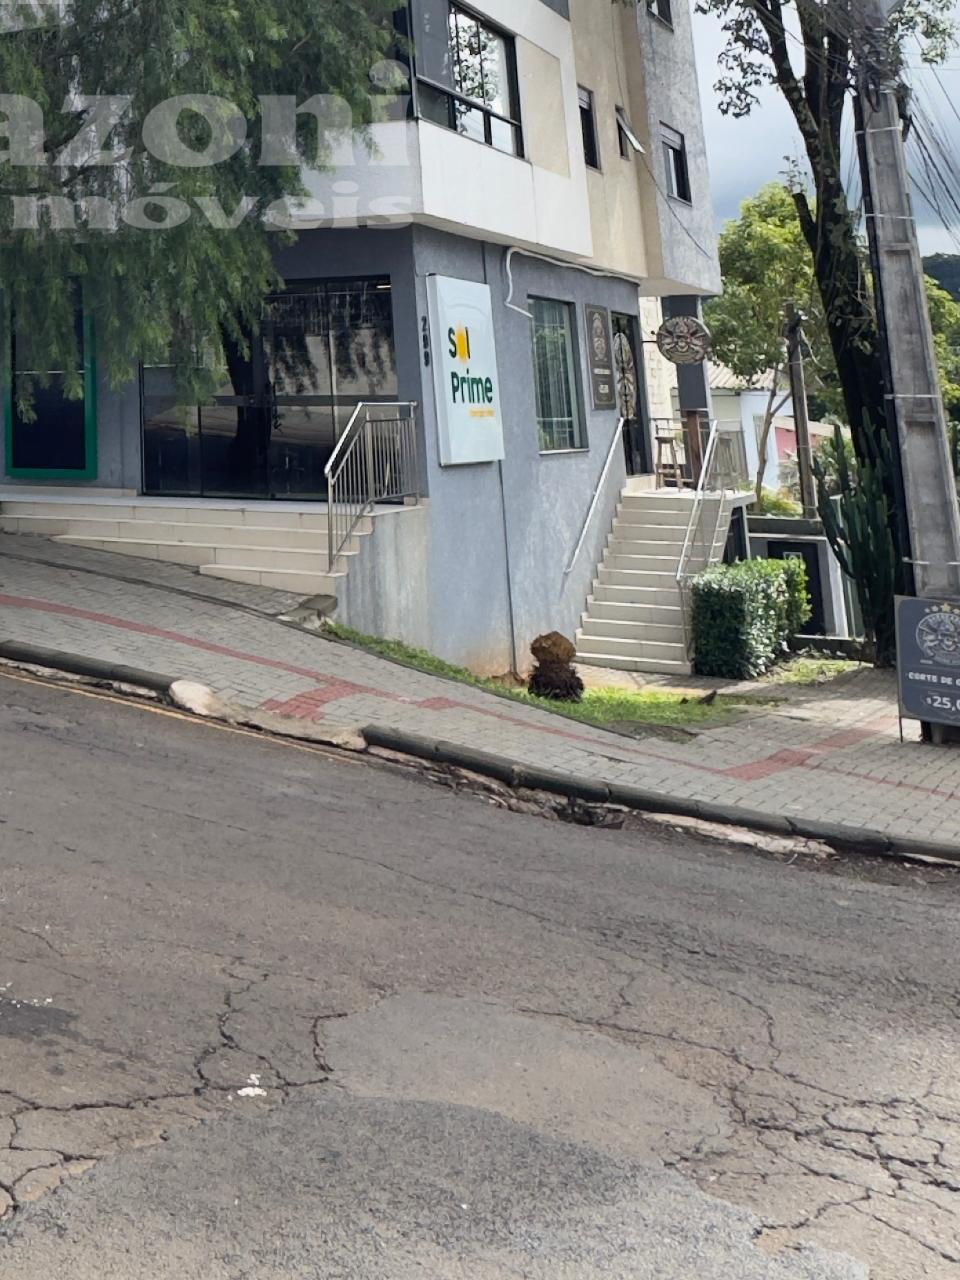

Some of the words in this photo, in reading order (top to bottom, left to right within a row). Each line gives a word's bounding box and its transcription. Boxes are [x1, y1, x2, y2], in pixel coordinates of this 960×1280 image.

[447, 323, 471, 363] Sol
[451, 368, 494, 404] Prime
[908, 671, 939, 683] CORTE
[940, 676, 953, 685] DE
